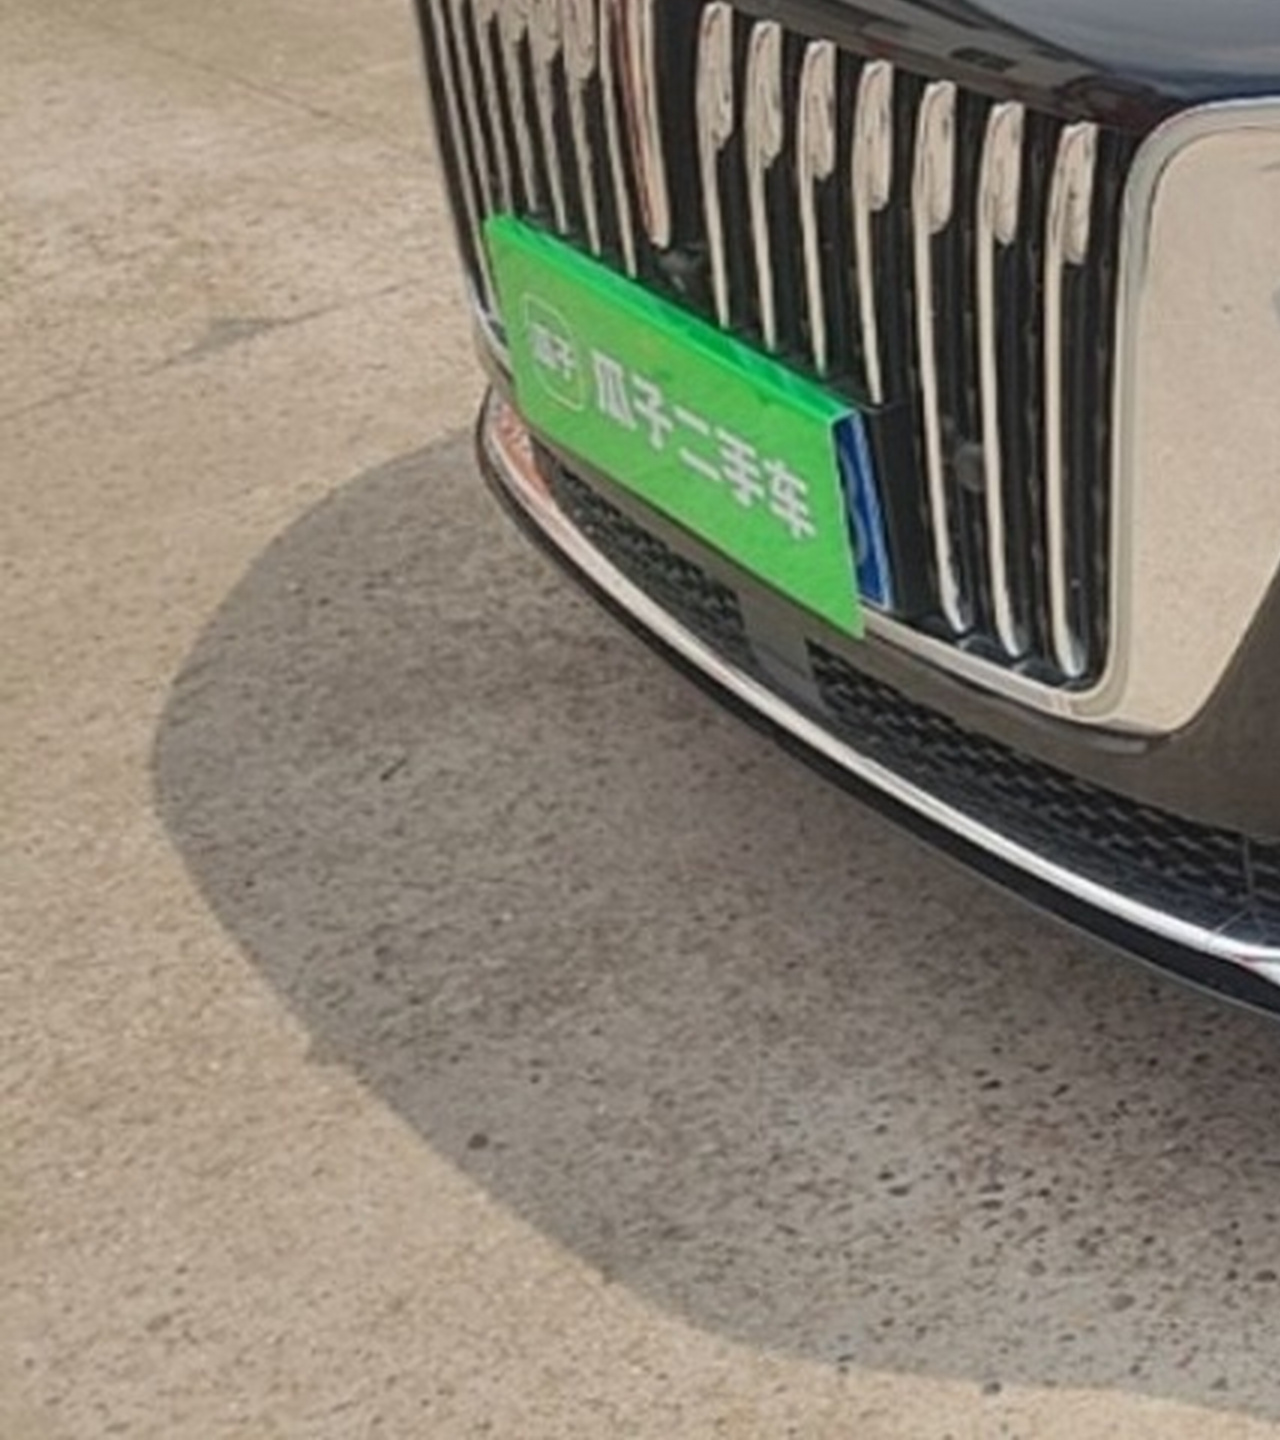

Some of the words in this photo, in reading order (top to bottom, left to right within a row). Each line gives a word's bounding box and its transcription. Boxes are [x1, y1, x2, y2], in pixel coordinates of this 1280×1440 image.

[591, 348, 816, 540] 瓜子二手车
